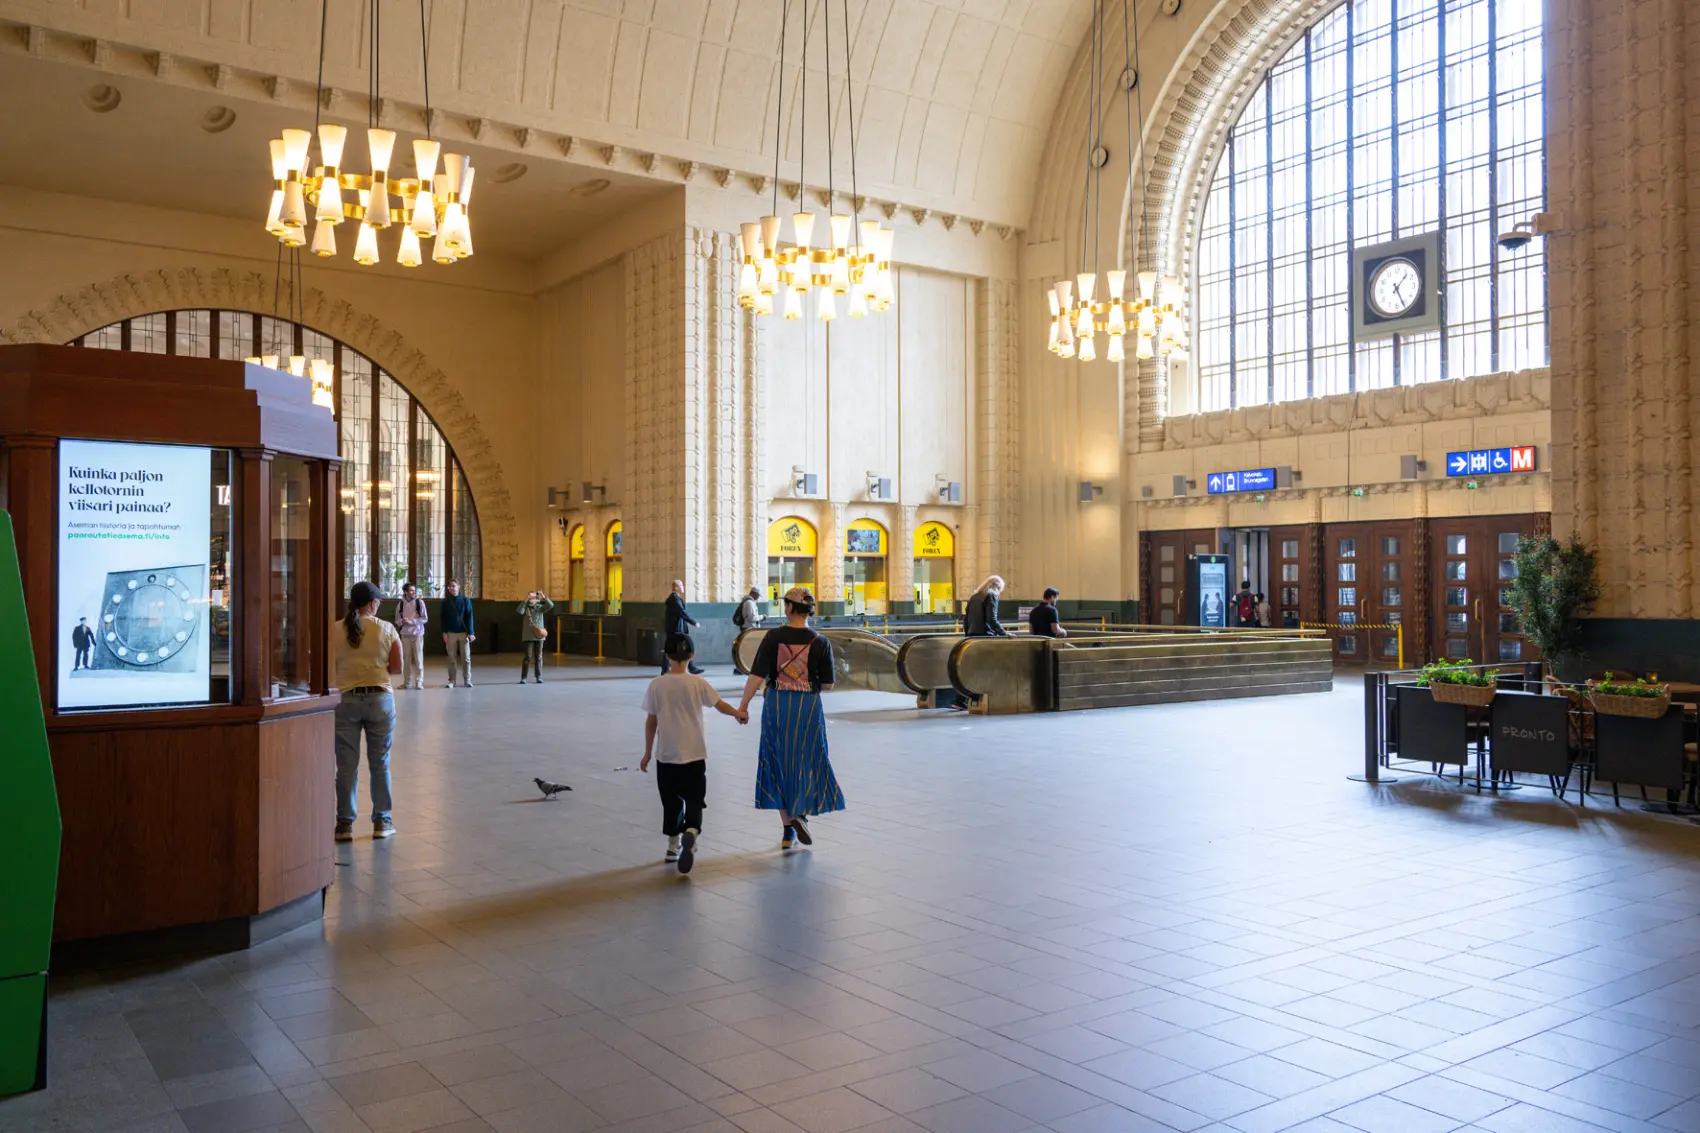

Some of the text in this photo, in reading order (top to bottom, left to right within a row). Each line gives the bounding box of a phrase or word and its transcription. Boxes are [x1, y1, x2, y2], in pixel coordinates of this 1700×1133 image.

[1513, 449, 1532, 469] M
[69, 466, 164, 483] Kuinka paljon
[69, 483, 145, 496] kellotornin
[69, 499, 171, 514] viisari painaa?
[99, 521, 127, 529] historia
[128, 523, 135, 531] ja
[67, 531, 171, 540] paarautatieasema.fi/info
[1502, 726, 1556, 741] PRONTO
